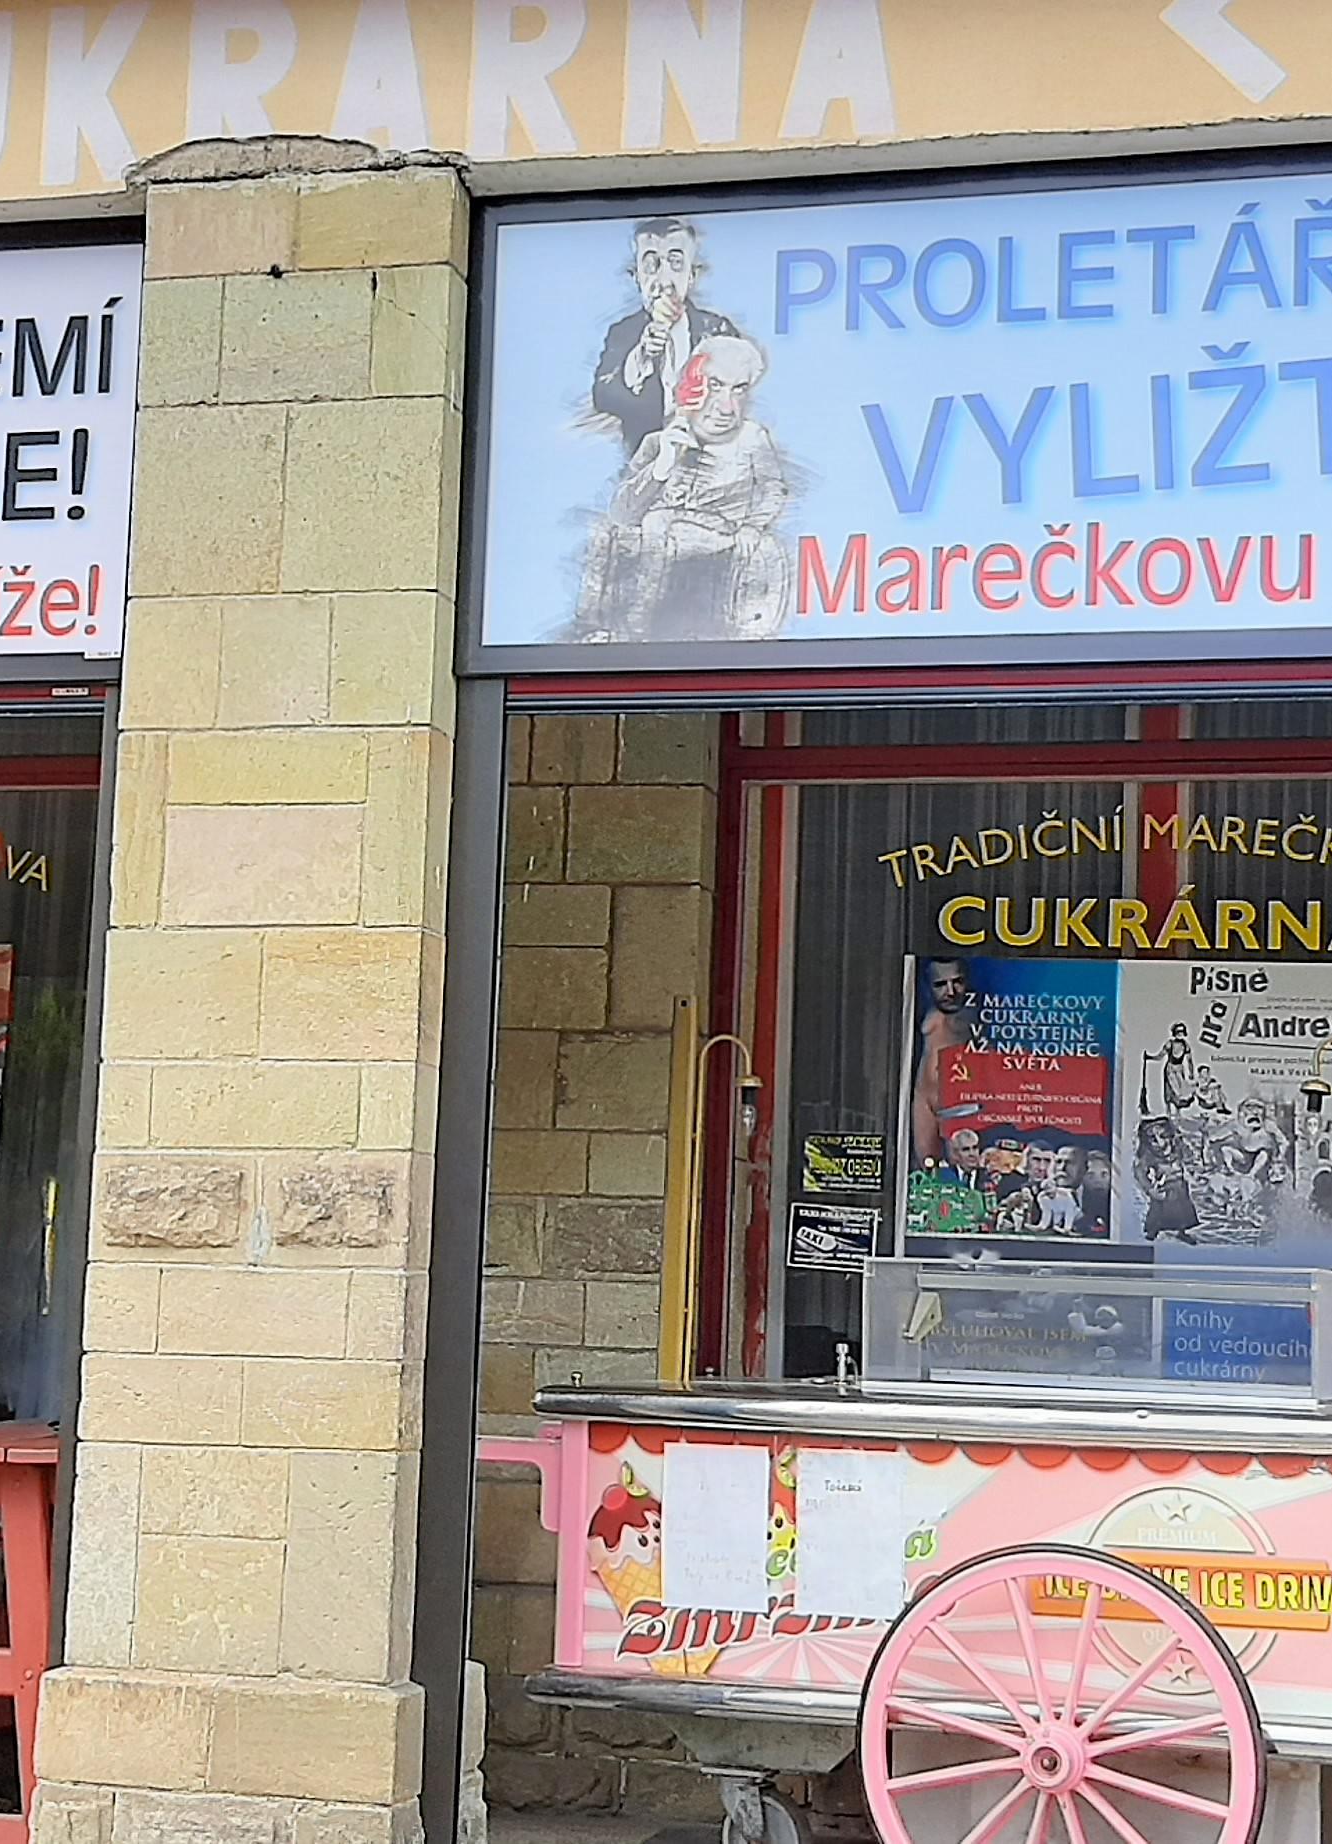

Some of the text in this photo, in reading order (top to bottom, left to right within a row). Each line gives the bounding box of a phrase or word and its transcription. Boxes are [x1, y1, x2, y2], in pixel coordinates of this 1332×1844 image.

[795, 522, 1312, 616] Marečkovu
[878, 805, 1123, 887] TRADIČNÍ
[1190, 966, 1268, 995] Písně
[965, 993, 1105, 1010] Z MAREČKOVY
[970, 1024, 1095, 1041] V POTŠTEJNĚ
[1199, 1000, 1227, 1048] pro
[964, 1037, 1099, 1056] AŽ NA KONEC
[1003, 1055, 1061, 1071] SVĚTA
[797, 1228, 824, 1246] TAXI
[1175, 1309, 1234, 1335] Knihy
[1175, 1336, 1201, 1352] od
[1174, 1361, 1266, 1383] cukrárny
[1137, 1527, 1217, 1544] PREMIUM
[1200, 1570, 1245, 1608] ICE
